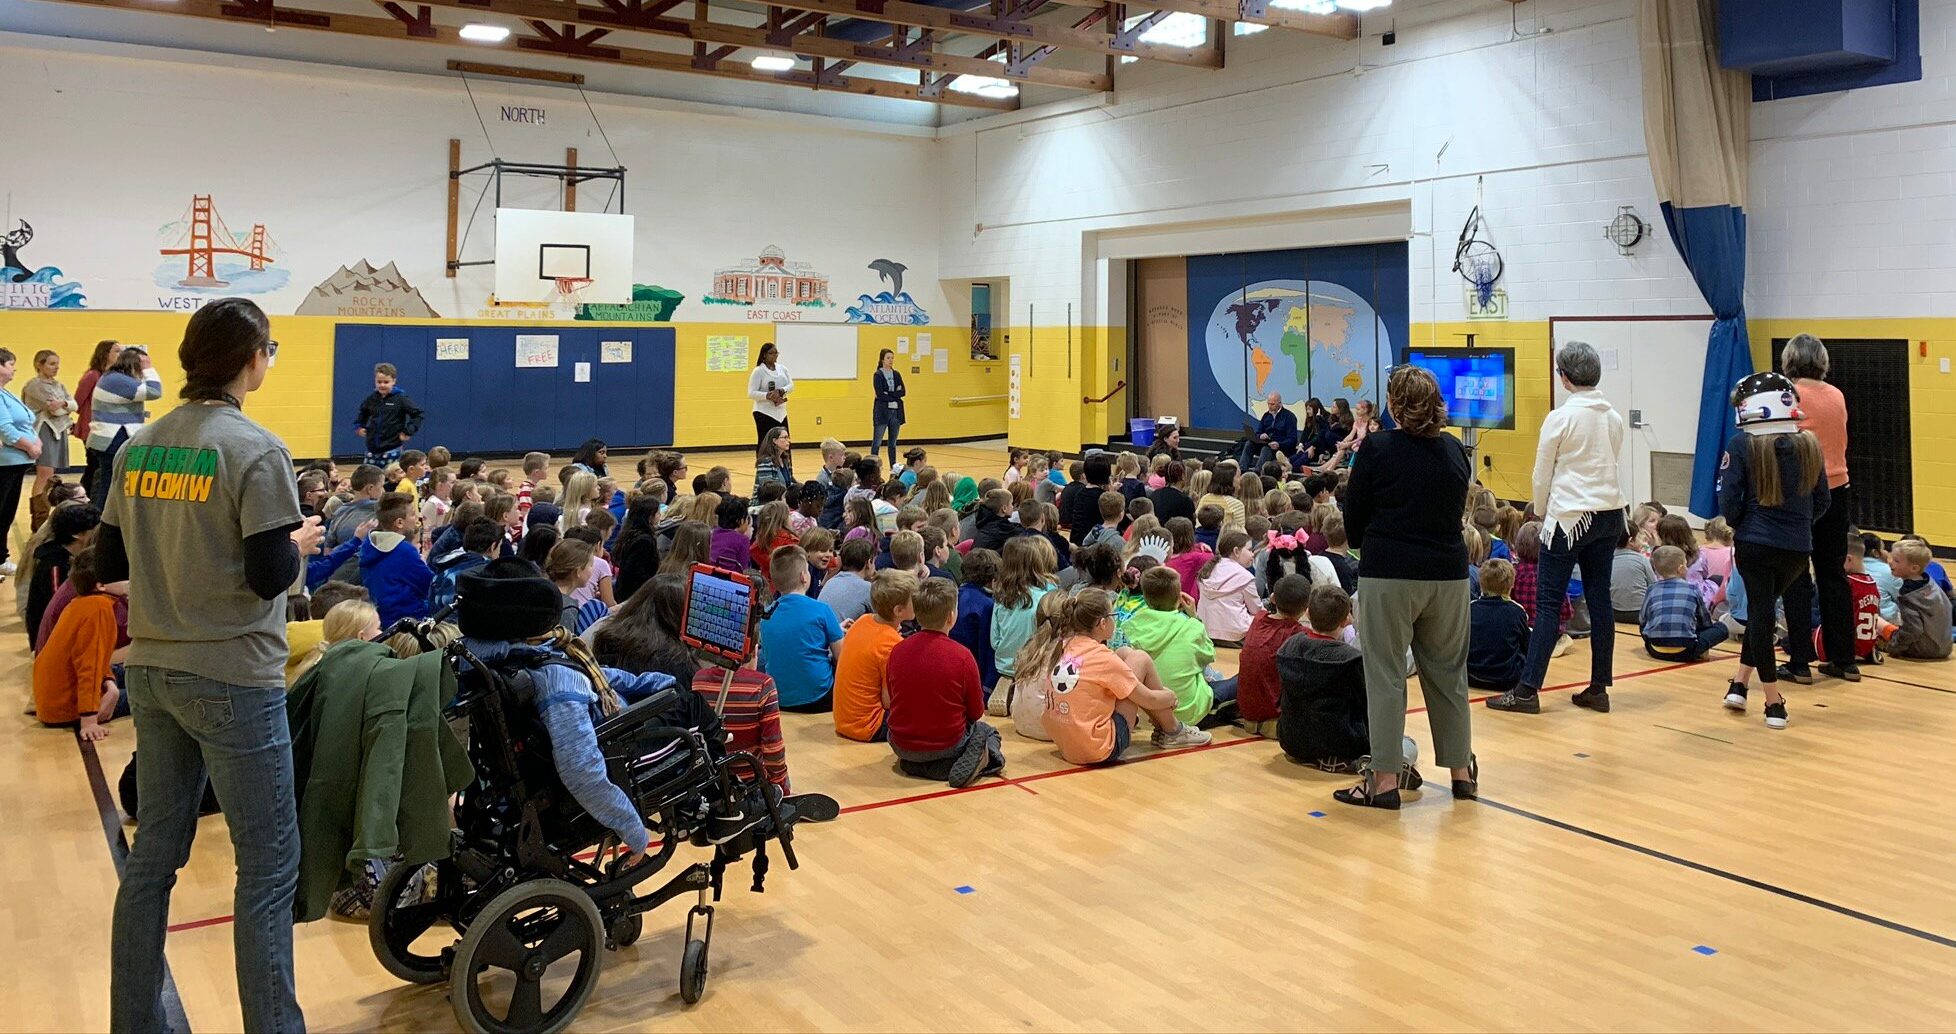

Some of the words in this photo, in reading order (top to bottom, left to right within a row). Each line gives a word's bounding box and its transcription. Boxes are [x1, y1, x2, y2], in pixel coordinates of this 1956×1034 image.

[501, 106, 545, 124] NORTH
[158, 297, 203, 309] WEST
[352, 296, 394, 307] ROCKY
[1470, 294, 1506, 315] EAST
[337, 306, 406, 317] MOUNTAINS
[590, 303, 660, 312] APPALACHIAN
[478, 309, 511, 319] GREAT
[517, 310, 556, 319] PLAINS
[595, 312, 653, 321] MOUNTAINS
[747, 310, 769, 320] EAST
[773, 311, 803, 320] COAST
[527, 350, 553, 365] FREE
